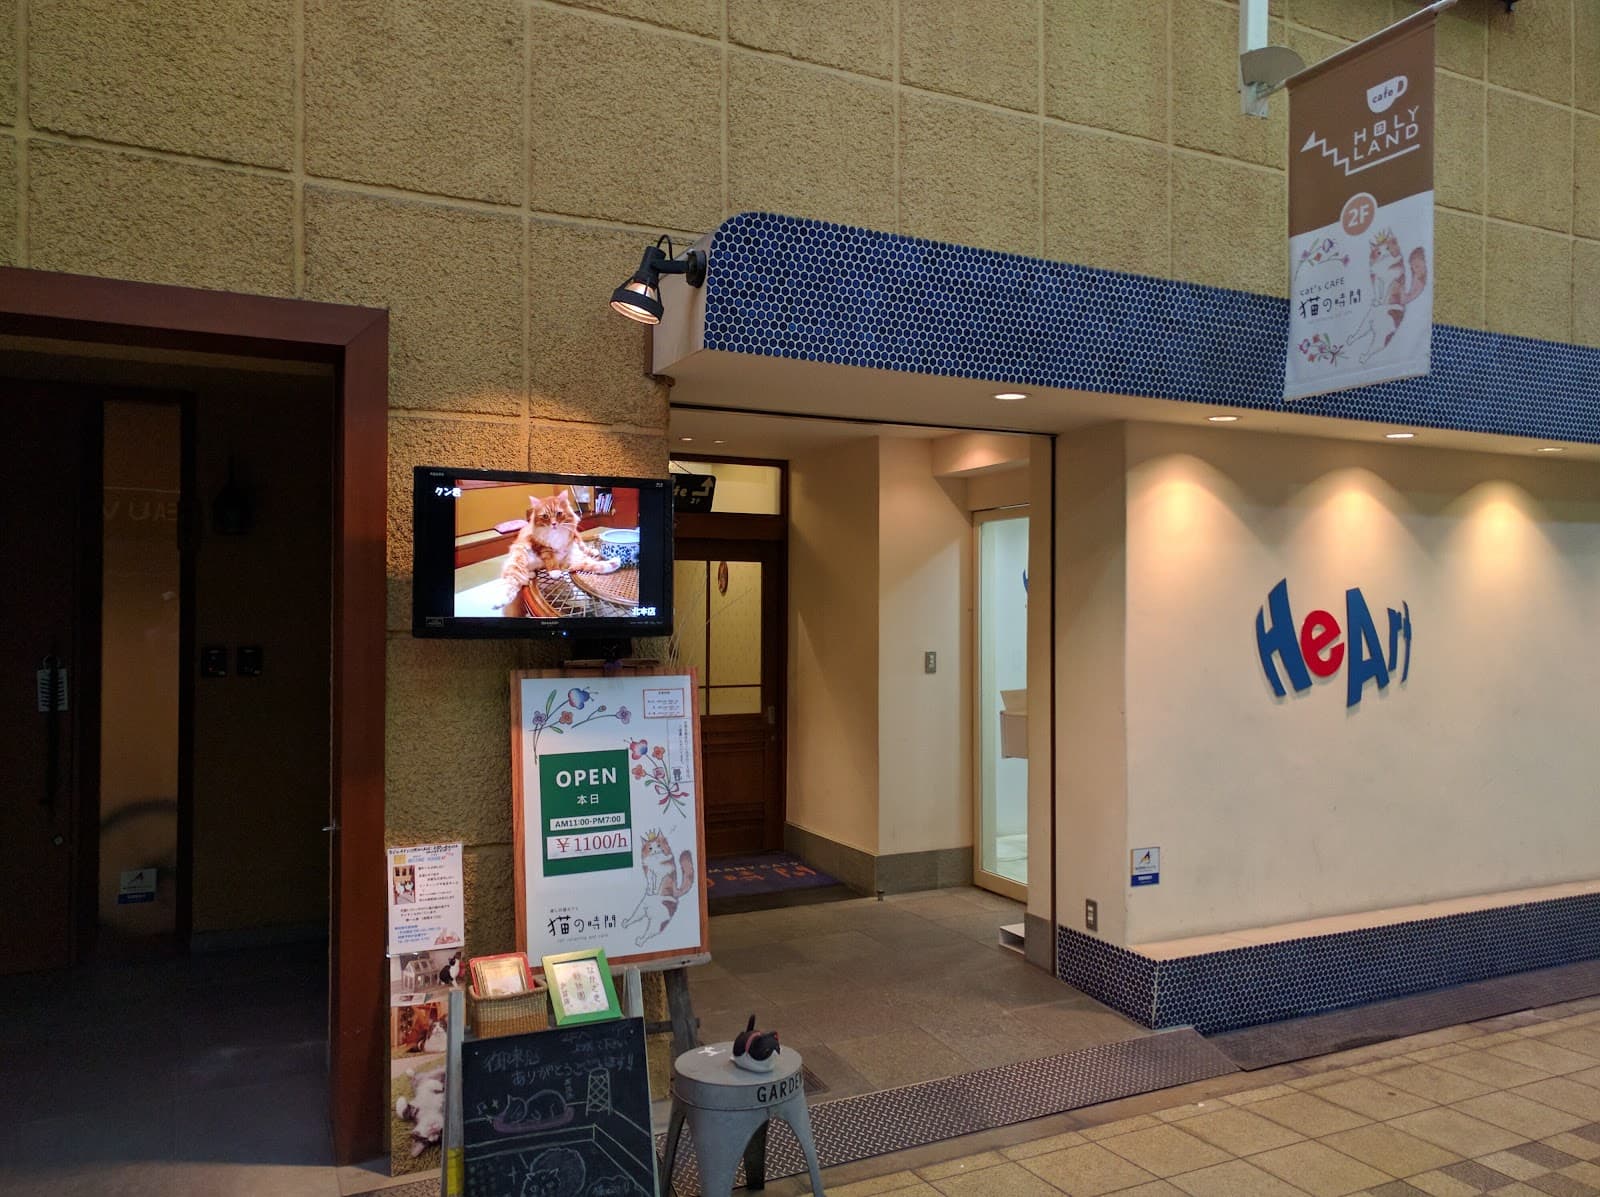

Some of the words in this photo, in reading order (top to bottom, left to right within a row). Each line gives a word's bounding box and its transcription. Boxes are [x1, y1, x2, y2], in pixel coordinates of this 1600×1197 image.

[1371, 85, 1394, 104] cafe
[1354, 123, 1419, 161] LAND
[1347, 205, 1371, 228] 2F
[555, 767, 617, 788] OPEN
[576, 793, 600, 805] 本日
[554, 815, 622, 828] AM11:00-PM7:00
[547, 914, 617, 937] 猫の時間
